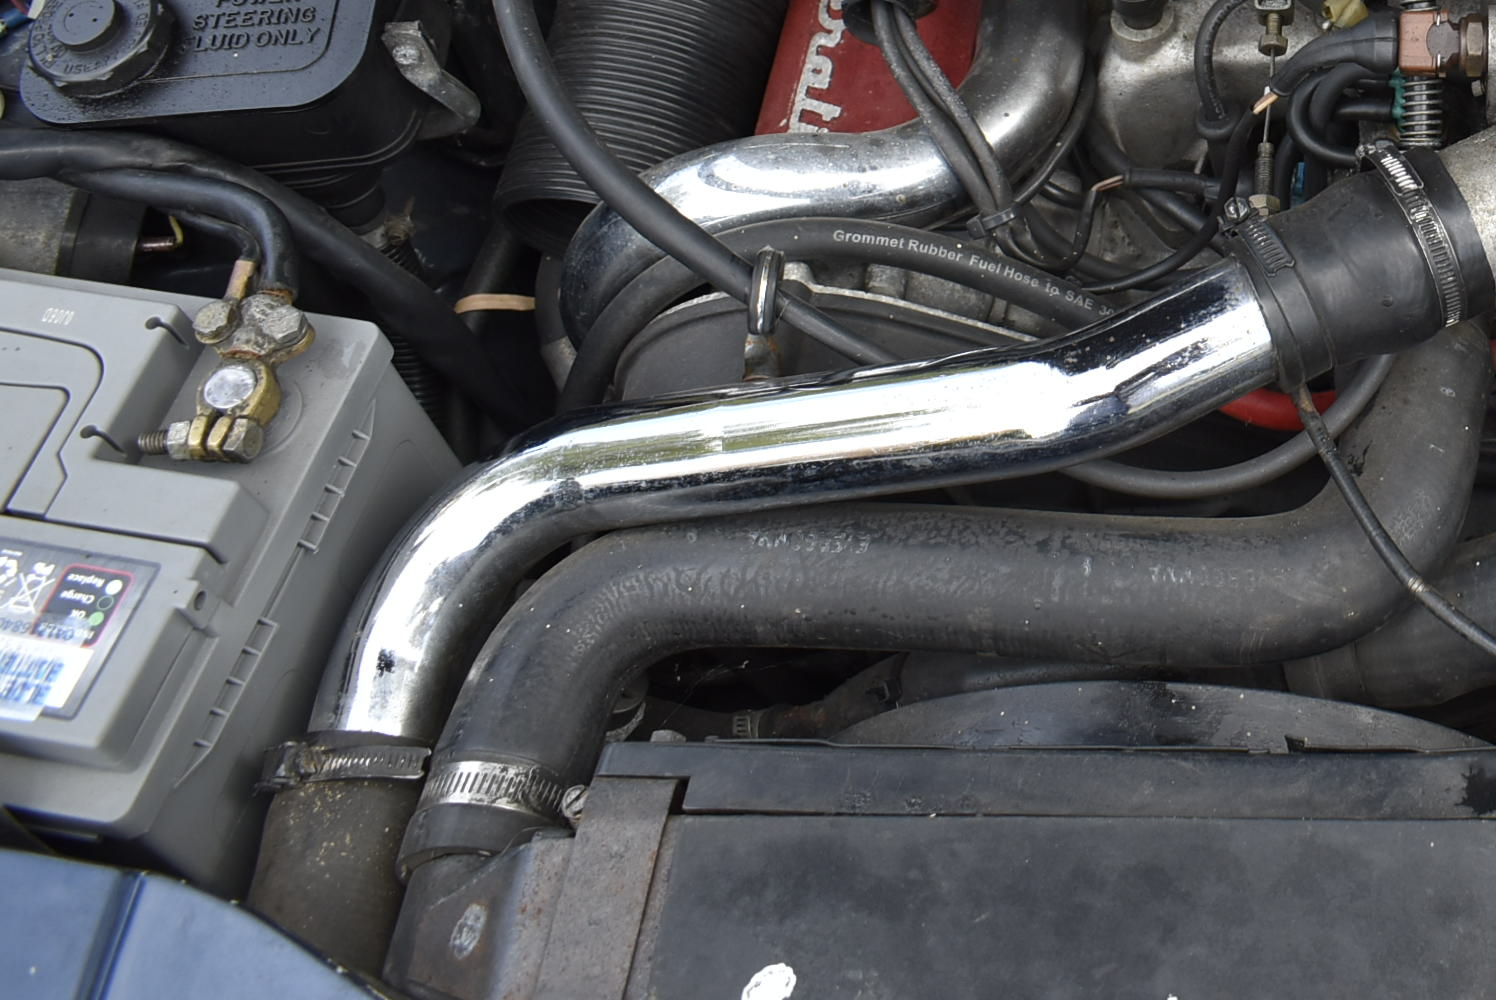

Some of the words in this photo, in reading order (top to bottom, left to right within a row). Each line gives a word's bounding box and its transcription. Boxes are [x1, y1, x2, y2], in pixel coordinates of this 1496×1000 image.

[192, 6, 317, 31] STEERING
[255, 27, 321, 48] ONLY
[832, 229, 905, 250] Grommet
[907, 239, 964, 263] Rubber
[968, 254, 1001, 276] Fuel
[1002, 266, 1040, 289] Hose
[1044, 279, 1061, 298] to
[1064, 289, 1095, 311] SAE
[65, 571, 107, 589] Replace
[59, 588, 96, 605] Charge
